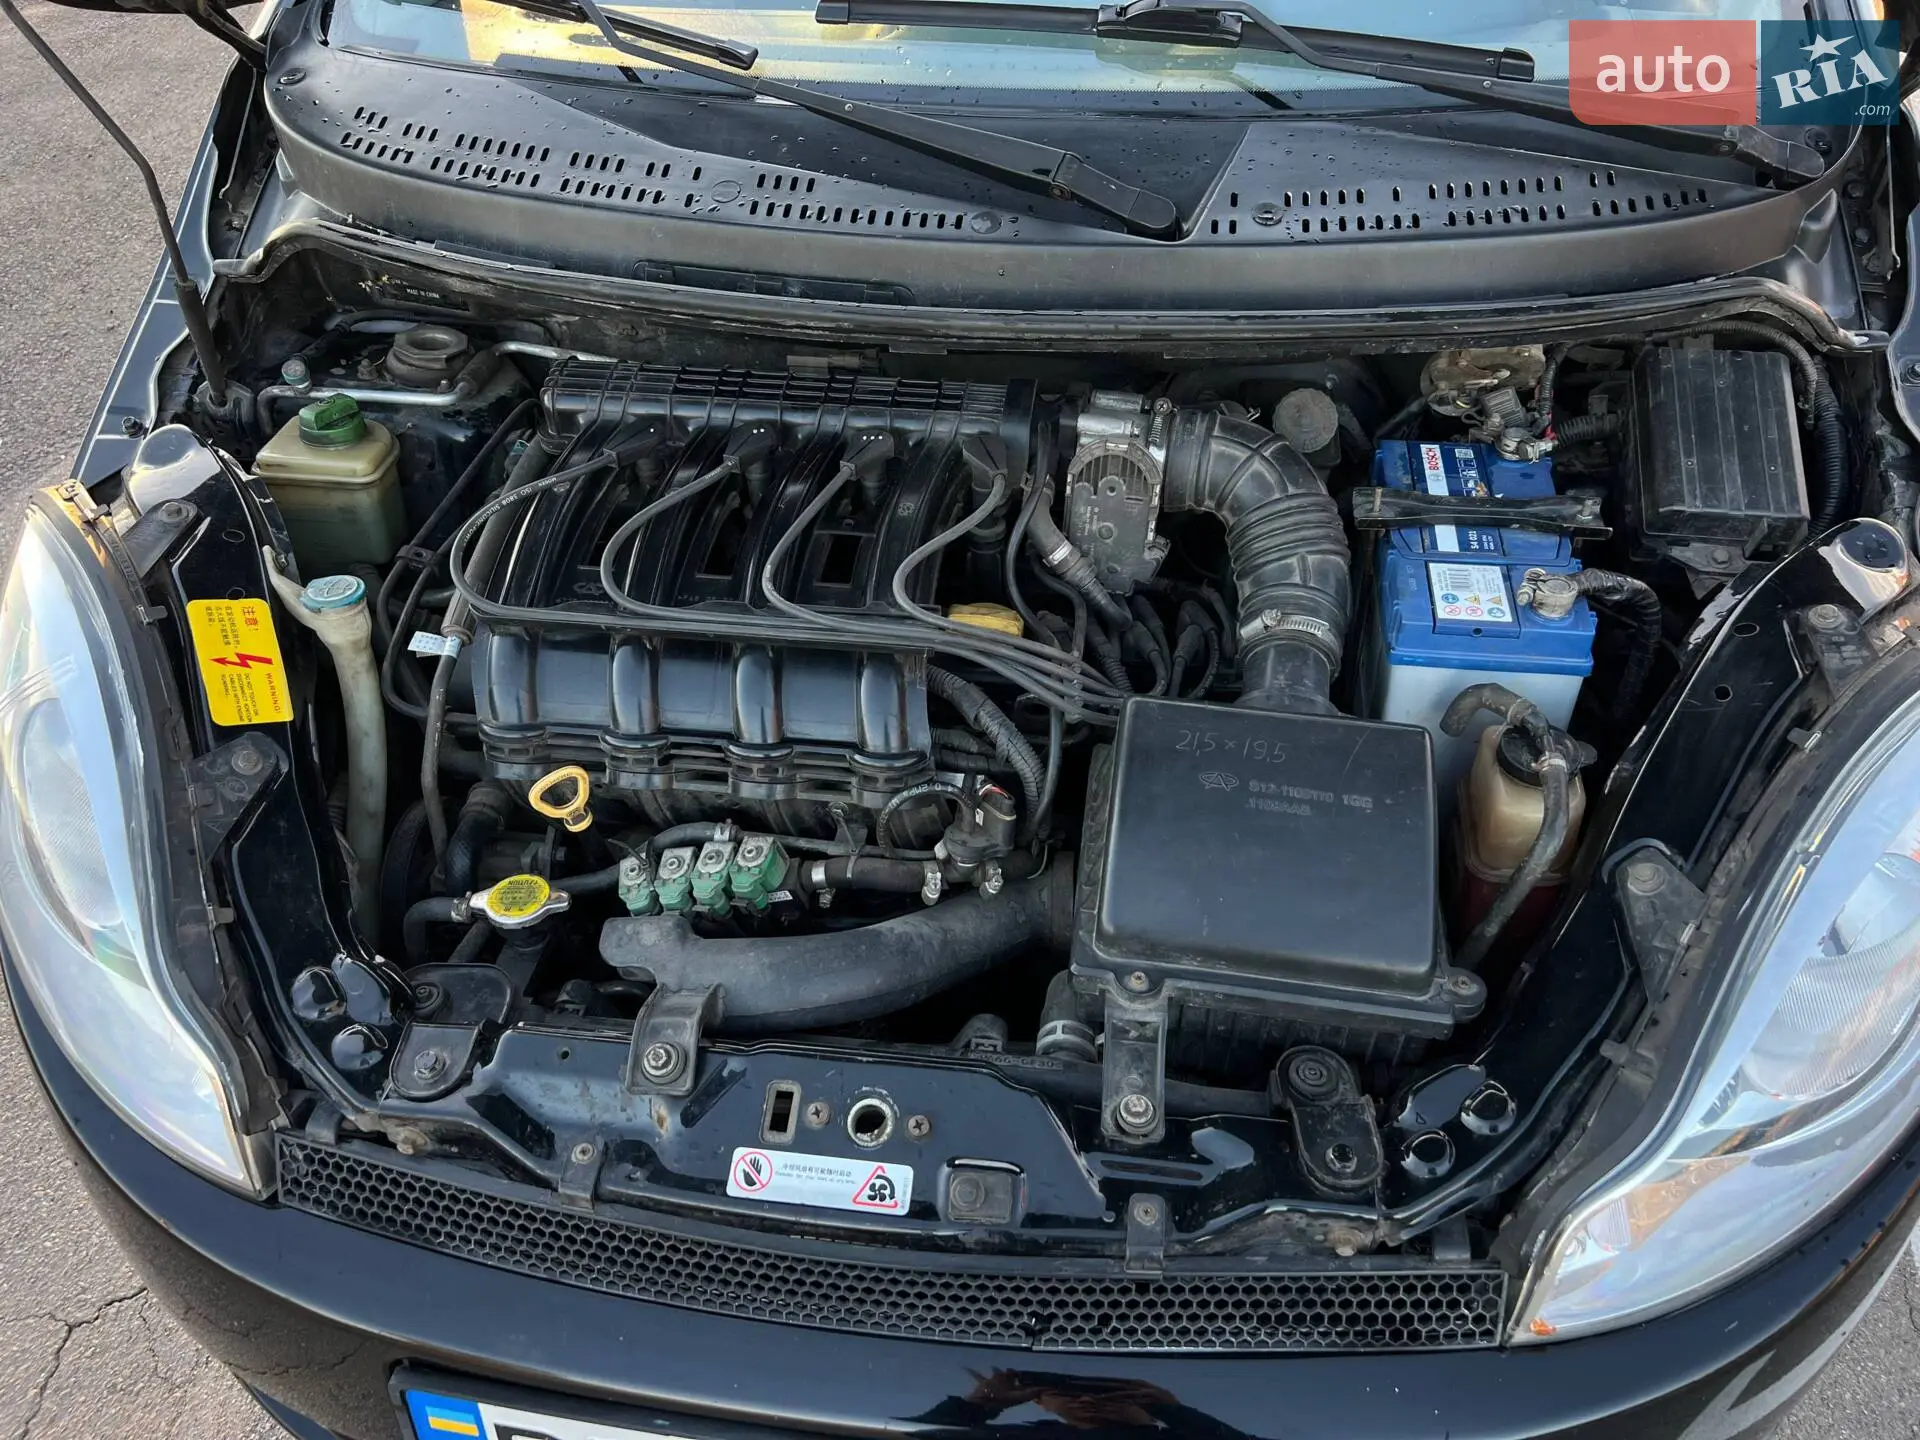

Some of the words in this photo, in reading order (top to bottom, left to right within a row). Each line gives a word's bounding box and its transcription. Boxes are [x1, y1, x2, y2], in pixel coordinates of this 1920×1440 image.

[426, 291, 440, 299] CHINA
[1426, 447, 1439, 470] BOSCH
[1469, 531, 1478, 540] 021
[249, 692, 257, 708] TOUCH
[265, 672, 281, 714] WARNING!
